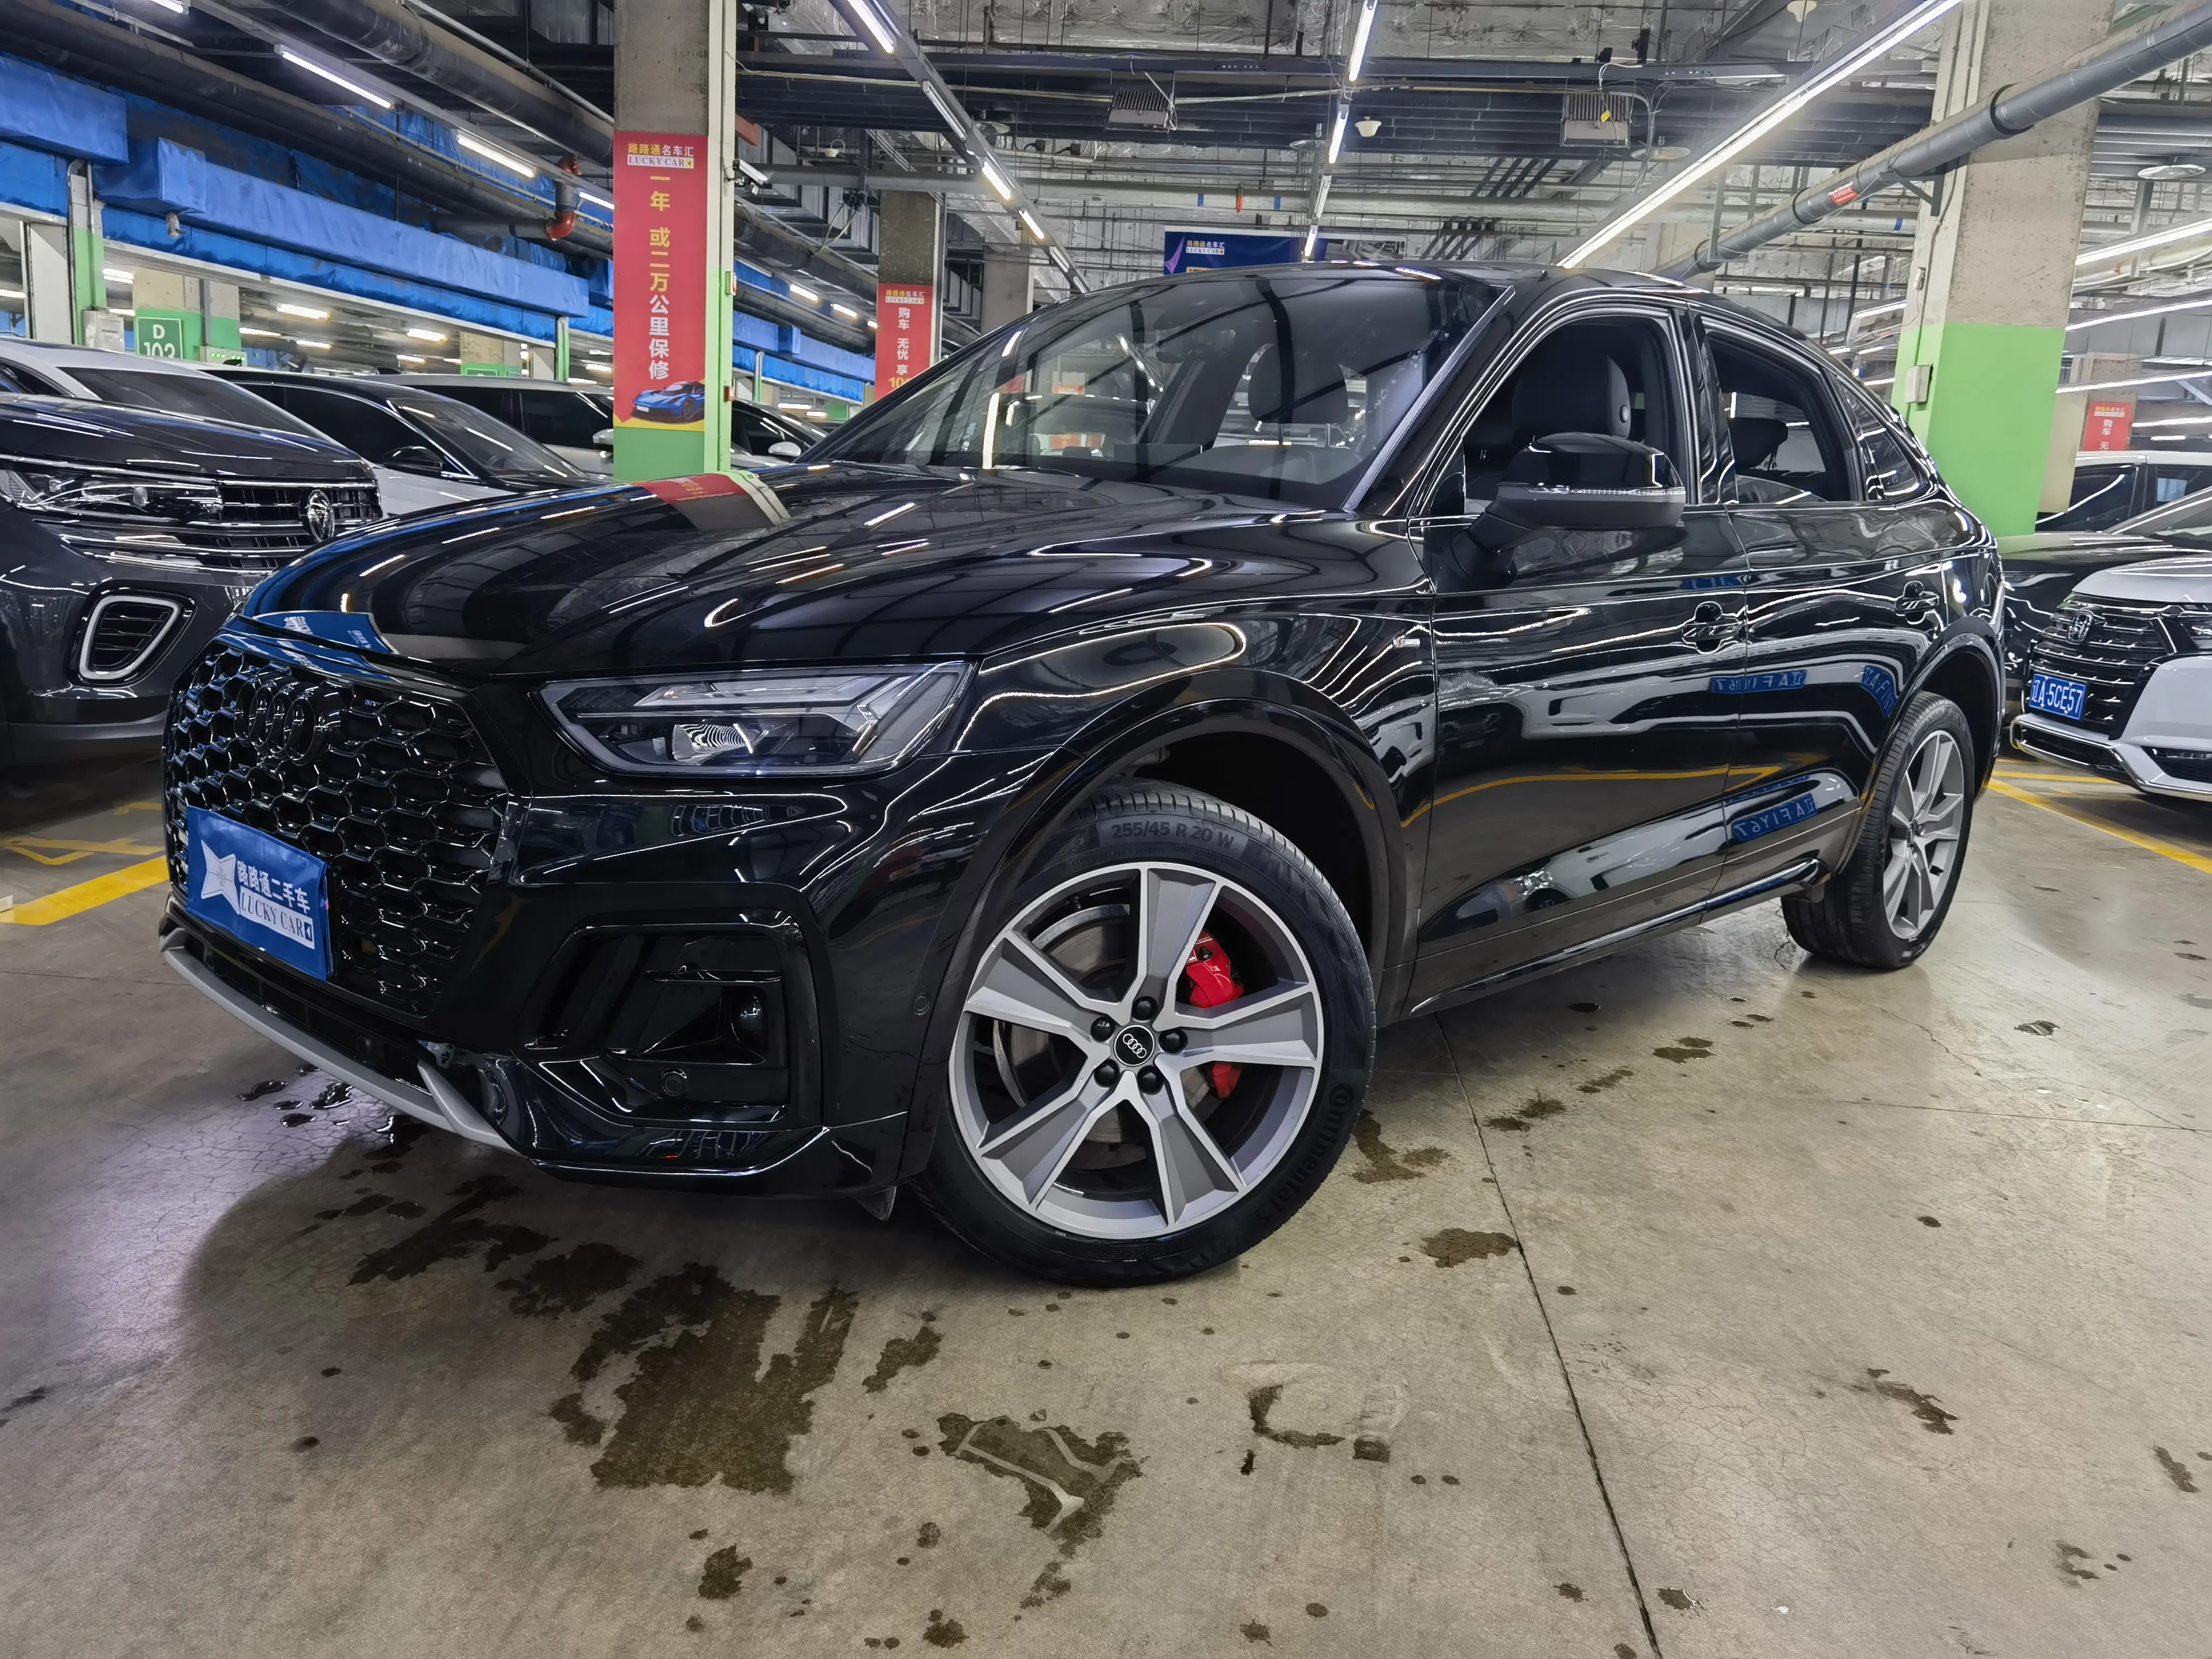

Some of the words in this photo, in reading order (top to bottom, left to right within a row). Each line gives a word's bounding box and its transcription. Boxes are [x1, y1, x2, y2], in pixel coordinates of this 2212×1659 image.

[628, 143, 694, 157] 路路通名车汇
[629, 156, 663, 165] LUCKY
[665, 158, 685, 166] CAR
[153, 324, 165, 339] D
[1111, 821, 1170, 839] 255/45
[1176, 822, 1188, 838] R
[1190, 825, 1213, 842] 20
[1218, 831, 1235, 850] W
[237, 860, 311, 914] 路路通二手车
[241, 892, 277, 926] LUCKY
[280, 911, 304, 938] CAR
